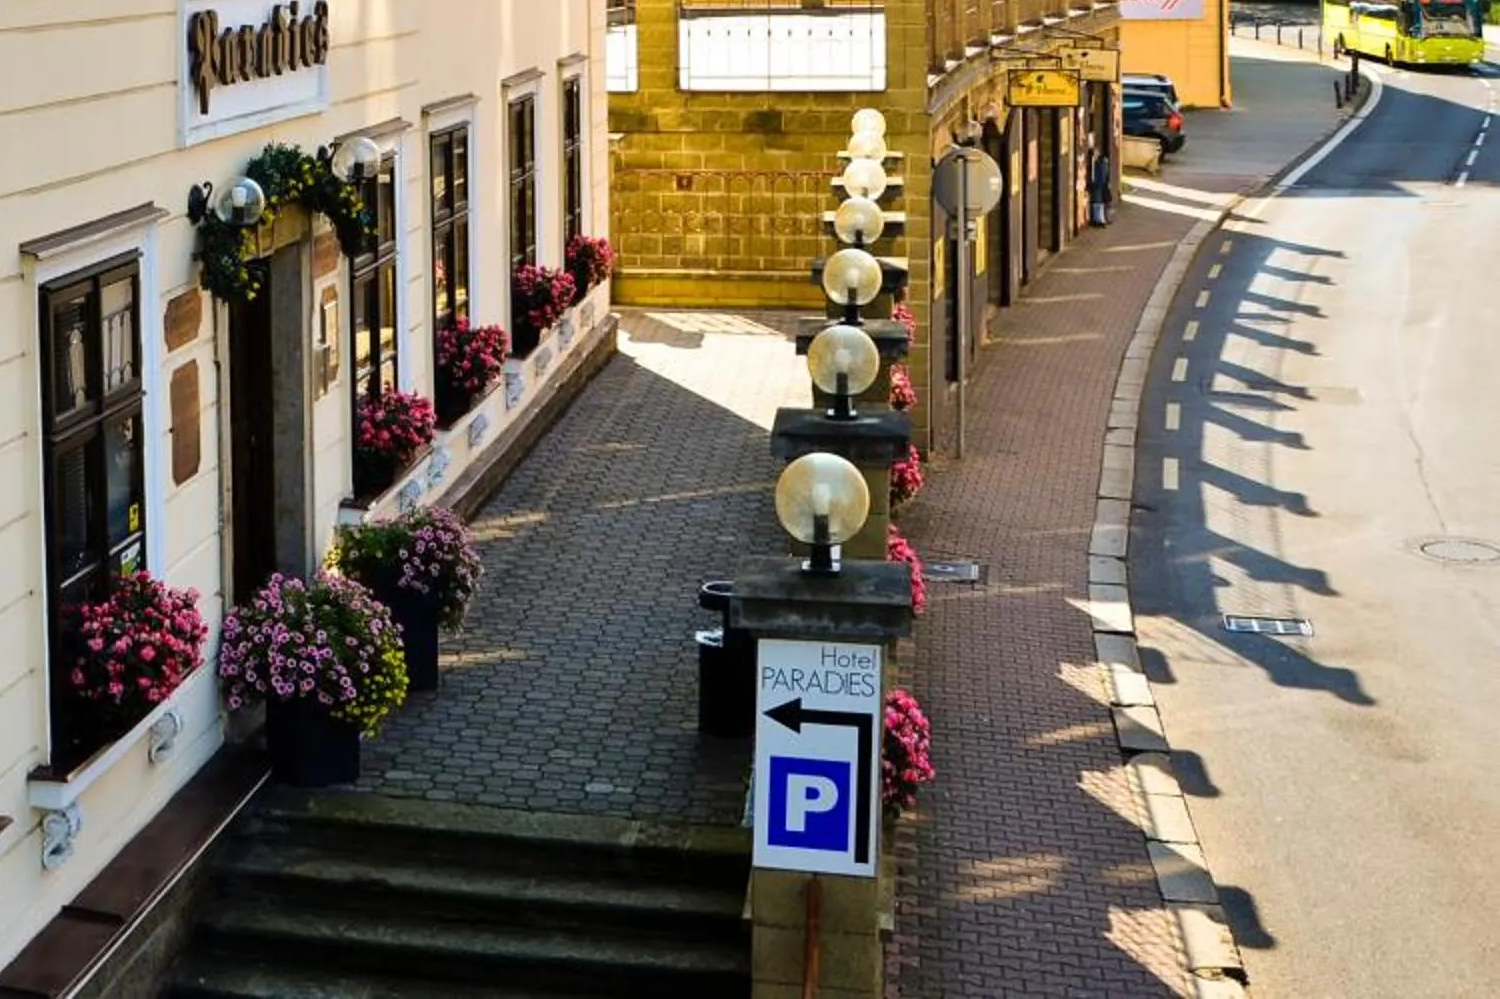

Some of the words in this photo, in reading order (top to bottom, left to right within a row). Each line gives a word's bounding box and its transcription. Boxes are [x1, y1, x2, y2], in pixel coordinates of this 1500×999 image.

[821, 646, 877, 670] Hotel
[761, 666, 876, 698] PARADIES
[785, 773, 839, 832] P
